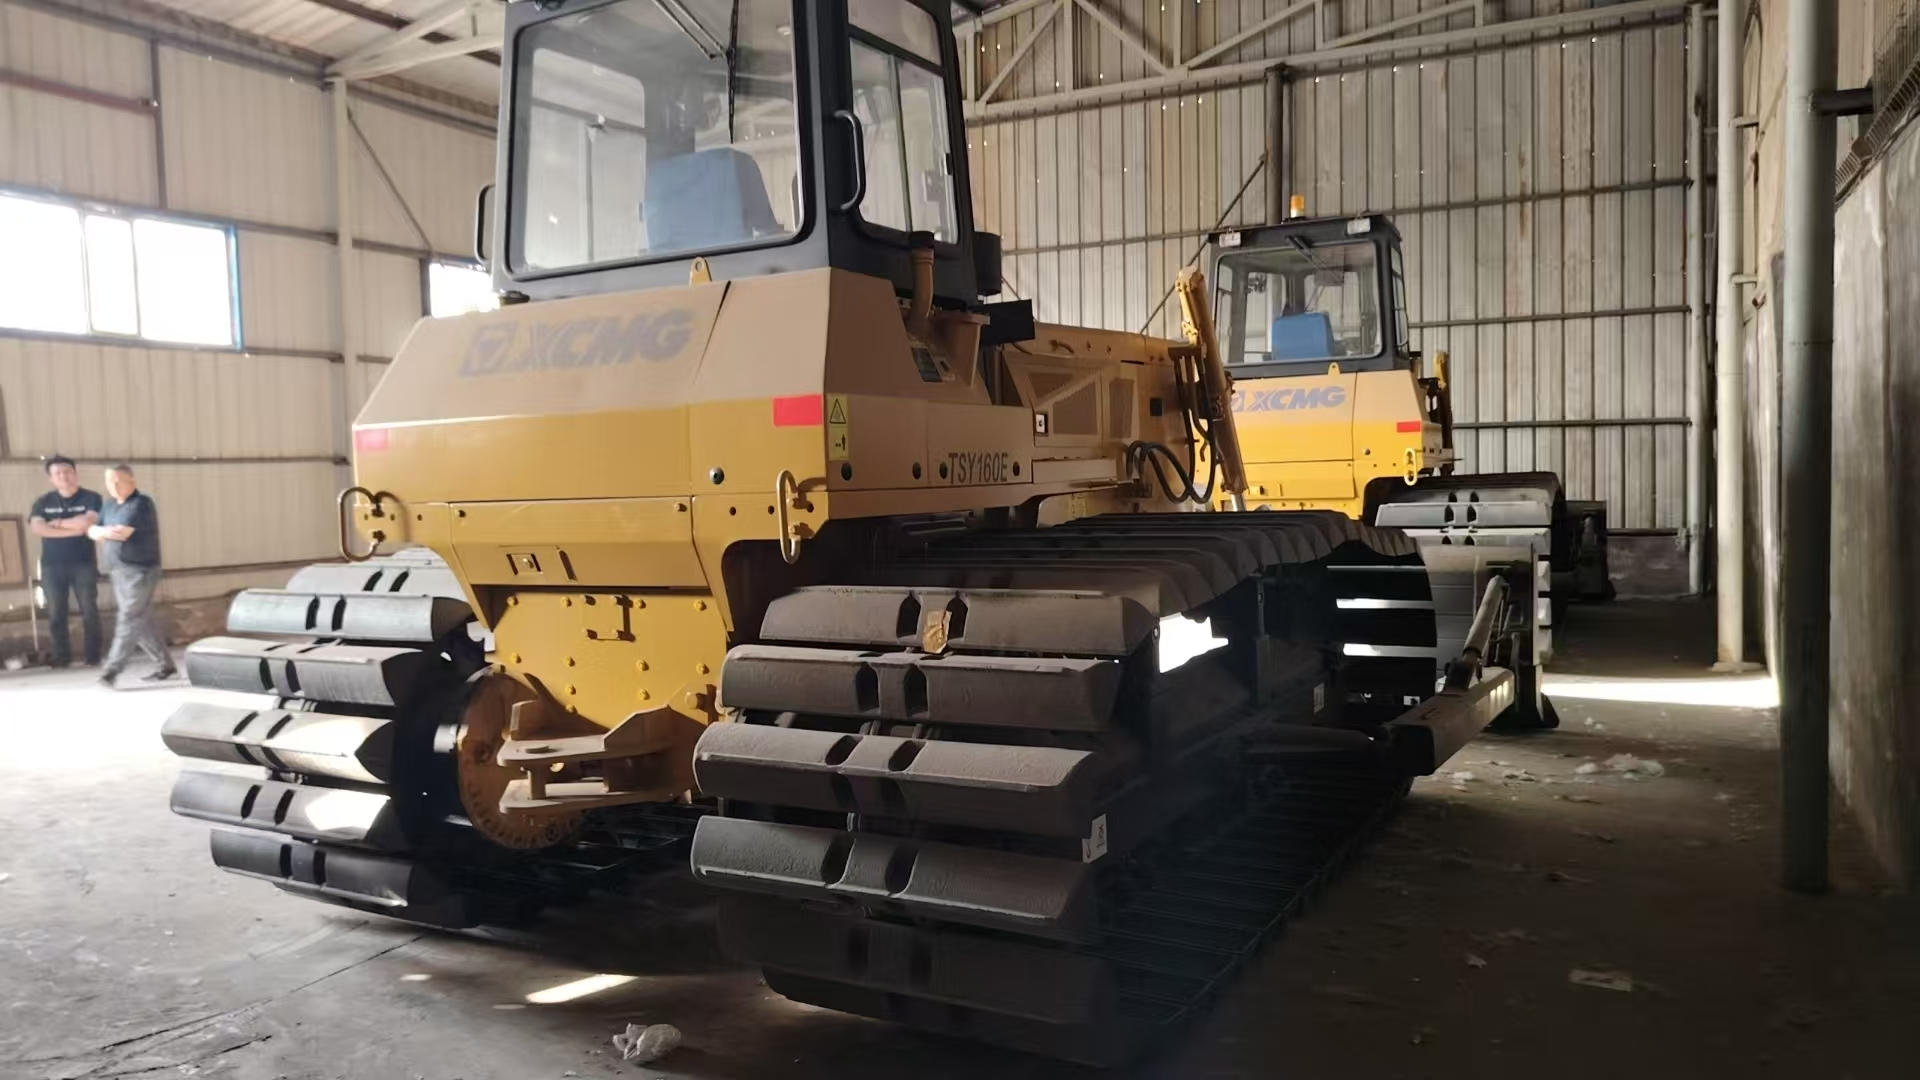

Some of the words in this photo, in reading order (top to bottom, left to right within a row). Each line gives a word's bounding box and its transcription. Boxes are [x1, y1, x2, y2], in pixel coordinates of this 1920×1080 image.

[513, 309, 694, 372] XCMG
[1248, 386, 1346, 412] XCMG
[948, 452, 1008, 484] TSY160E
